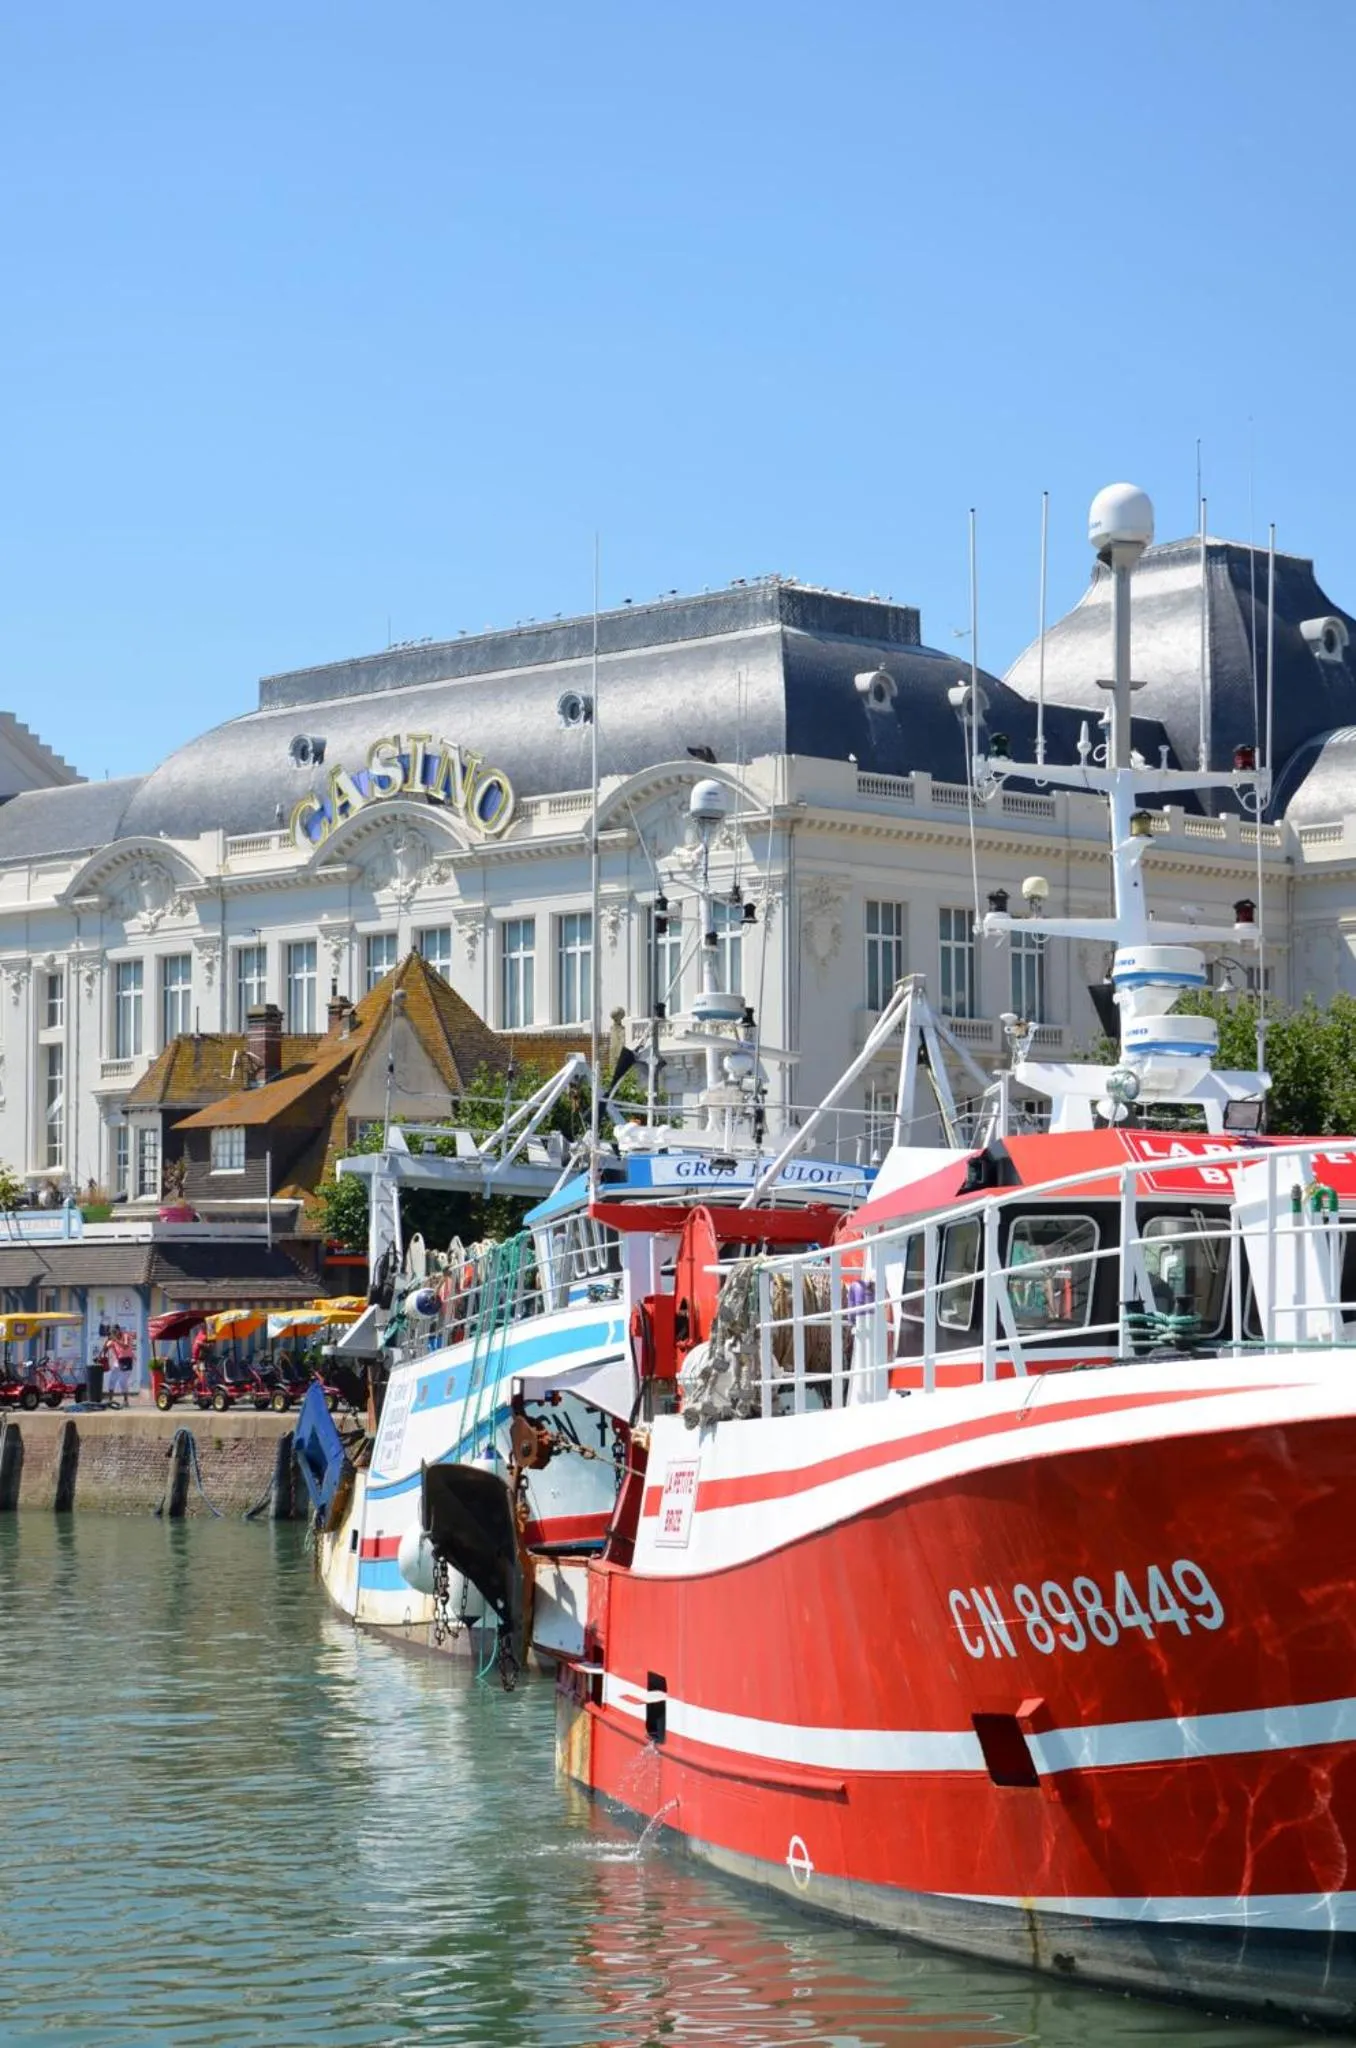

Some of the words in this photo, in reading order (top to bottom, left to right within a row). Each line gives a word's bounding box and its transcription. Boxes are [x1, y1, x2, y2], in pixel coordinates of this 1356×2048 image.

[289, 731, 514, 852] CASINO
[949, 1587, 1017, 1658] CN
[1013, 1559, 1224, 1654] 898449
